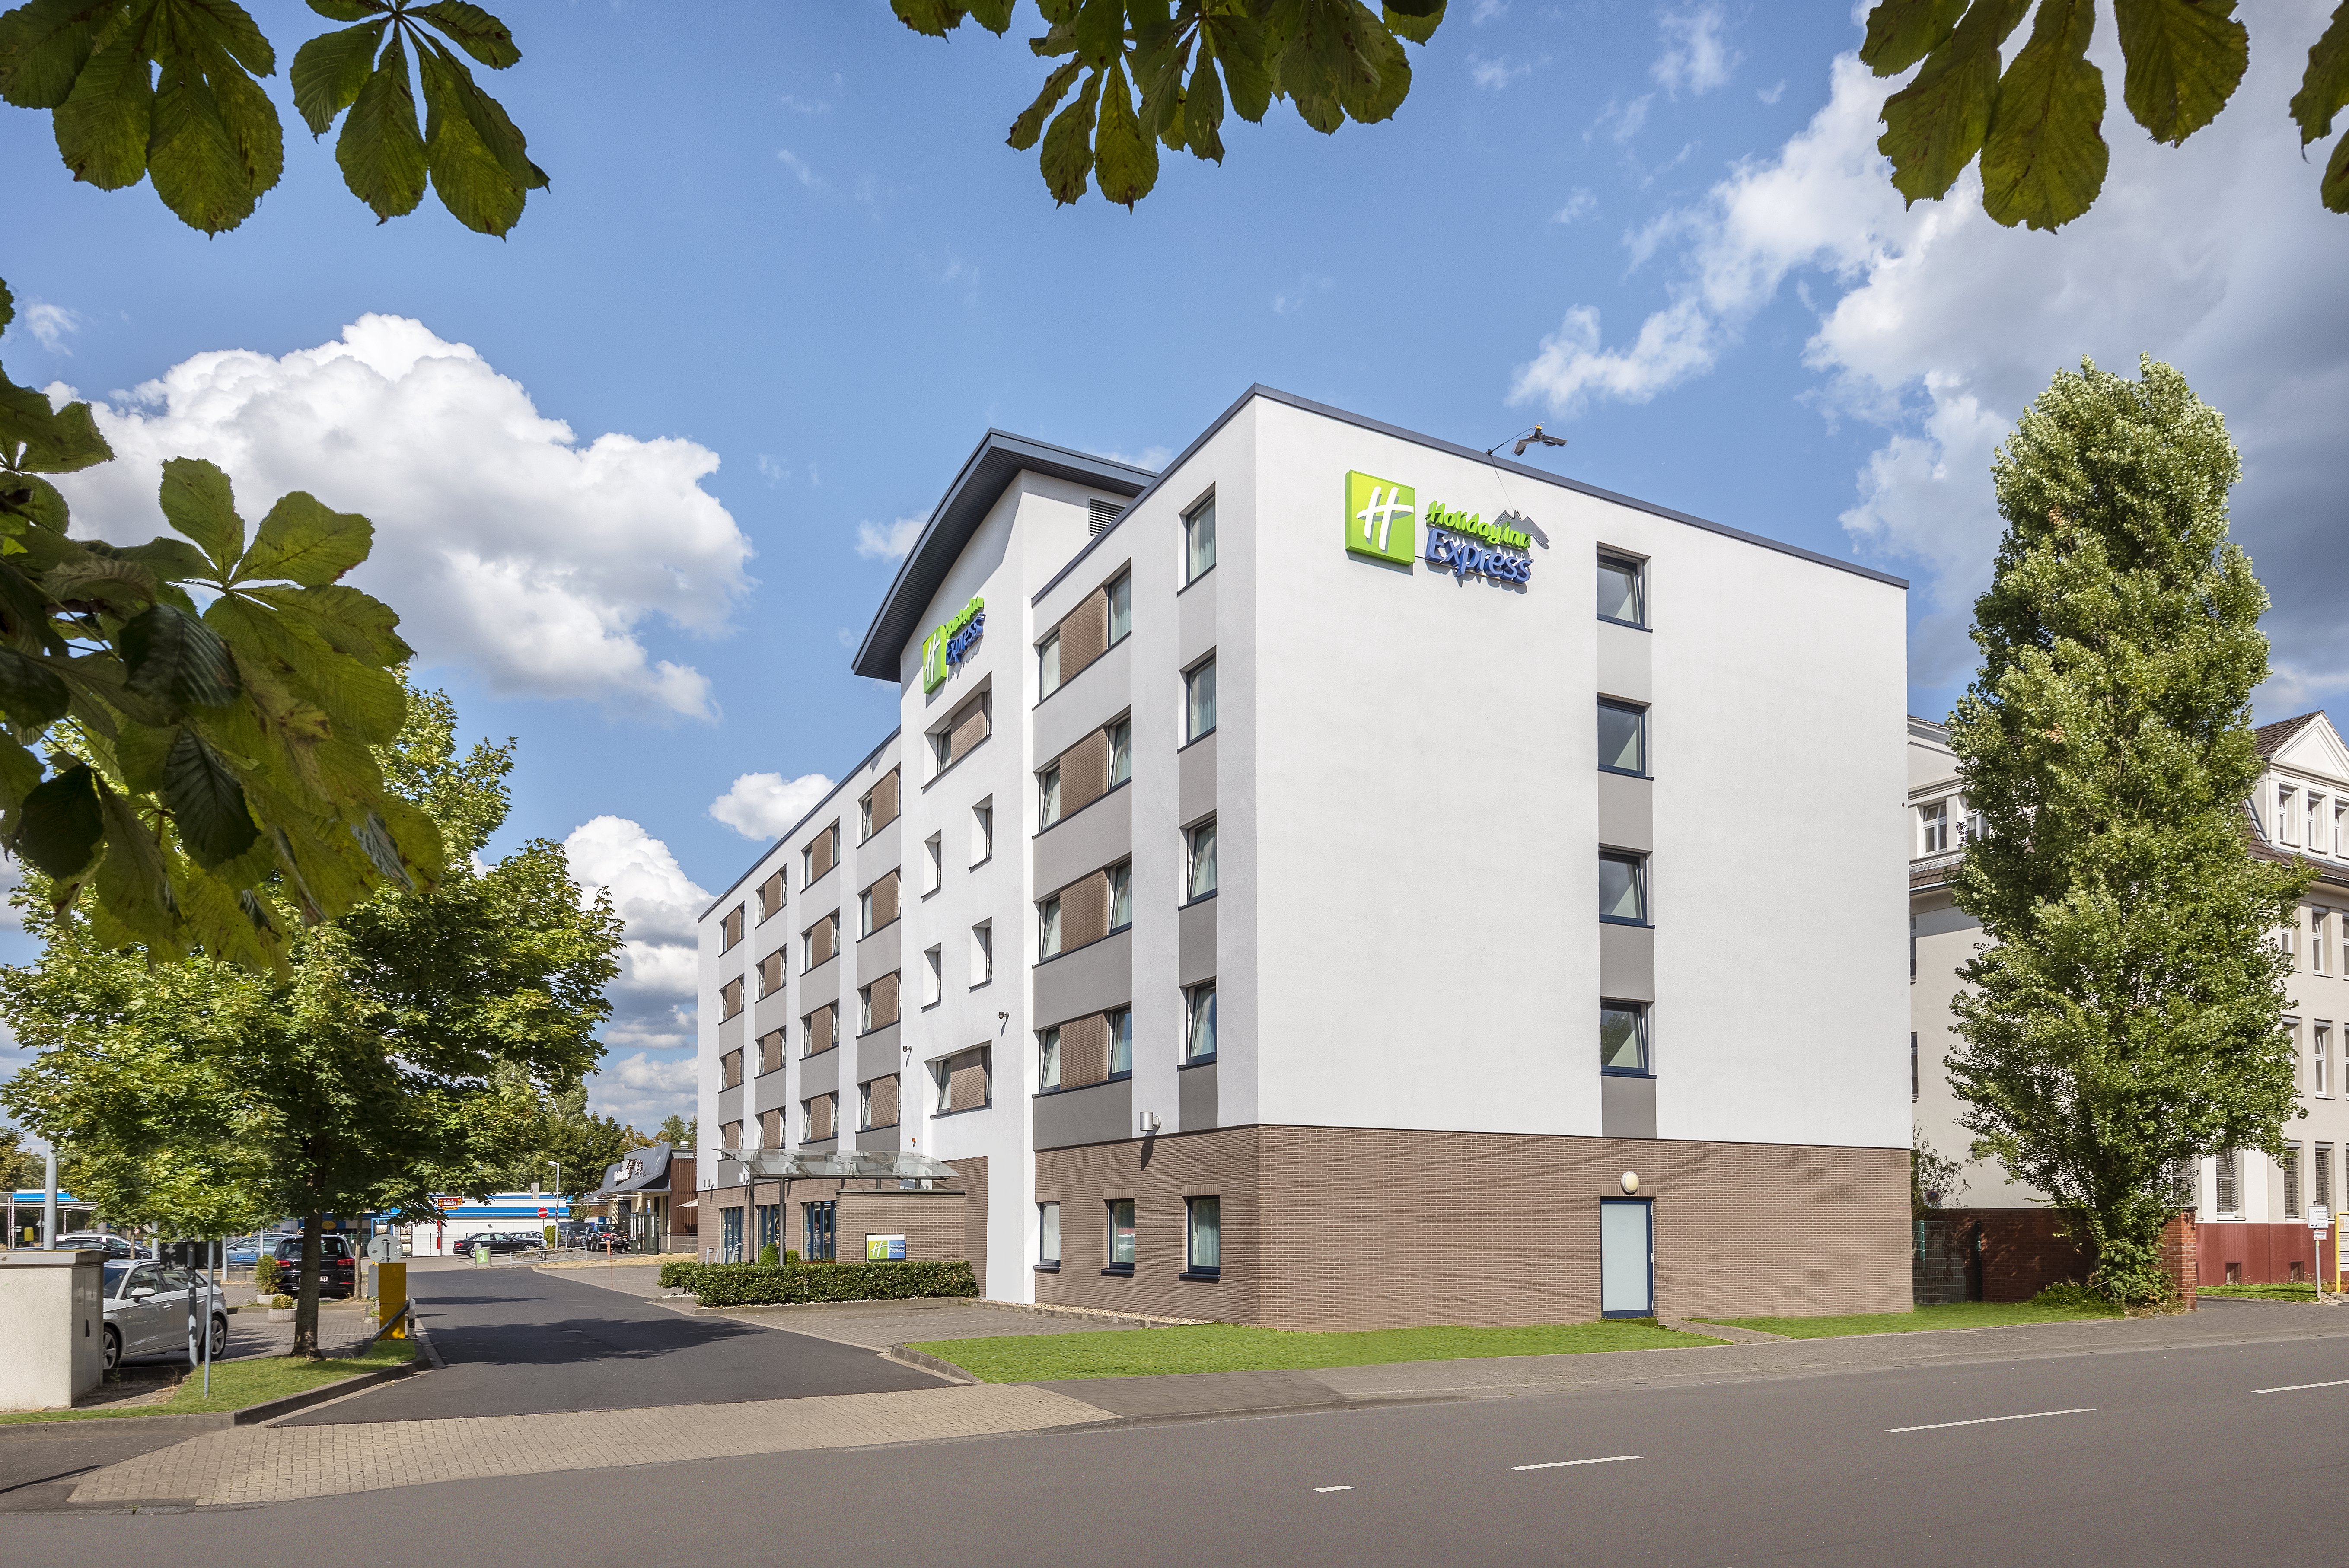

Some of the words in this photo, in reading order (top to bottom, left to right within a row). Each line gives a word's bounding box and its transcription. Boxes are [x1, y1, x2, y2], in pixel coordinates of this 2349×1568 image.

[1425, 500, 1501, 545] Holiday
[1500, 521, 1531, 551] Inn
[1425, 528, 1533, 583] Express
